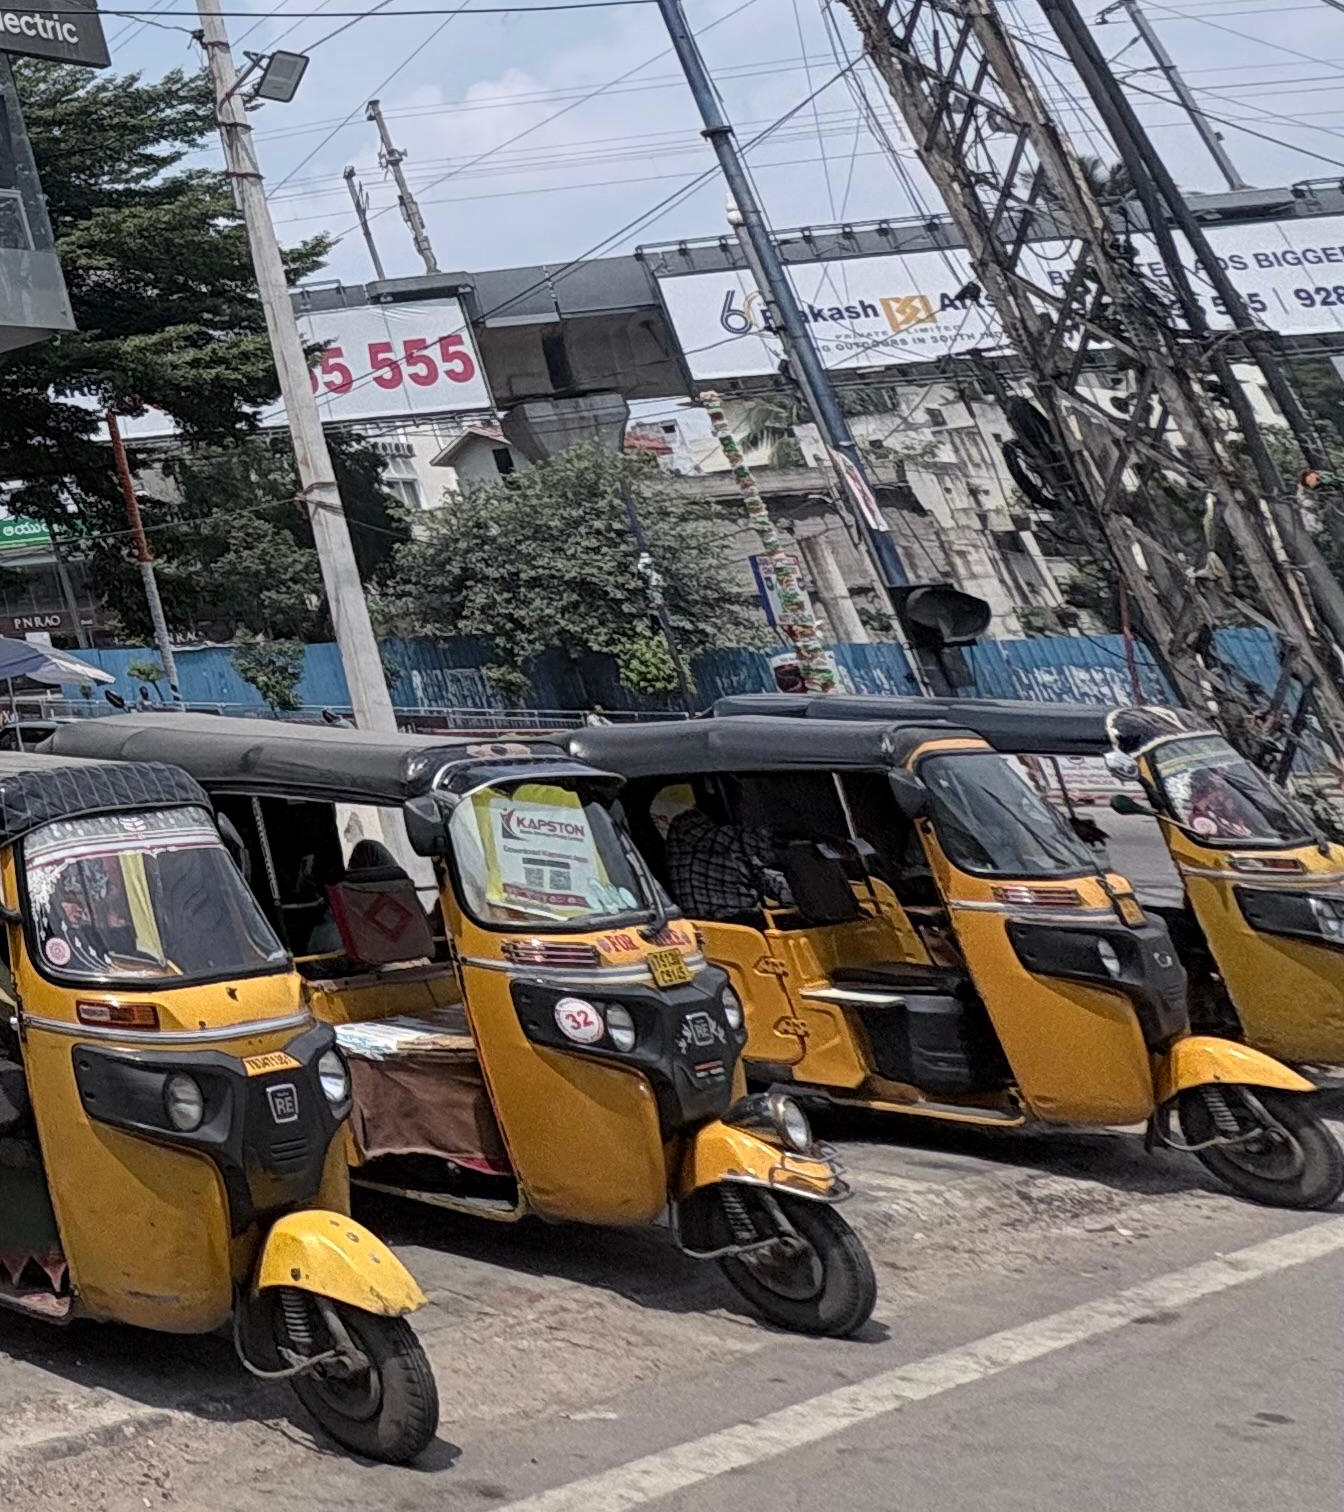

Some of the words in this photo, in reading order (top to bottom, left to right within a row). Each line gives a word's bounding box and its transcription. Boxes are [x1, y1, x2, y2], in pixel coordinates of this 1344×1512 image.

[1252, 246, 1344, 269] BIGGE
[367, 334, 476, 390] 555
[515, 815, 586, 837] KAPSTON
[565, 1009, 595, 1031] 32
[274, 1096, 294, 1116] RE
